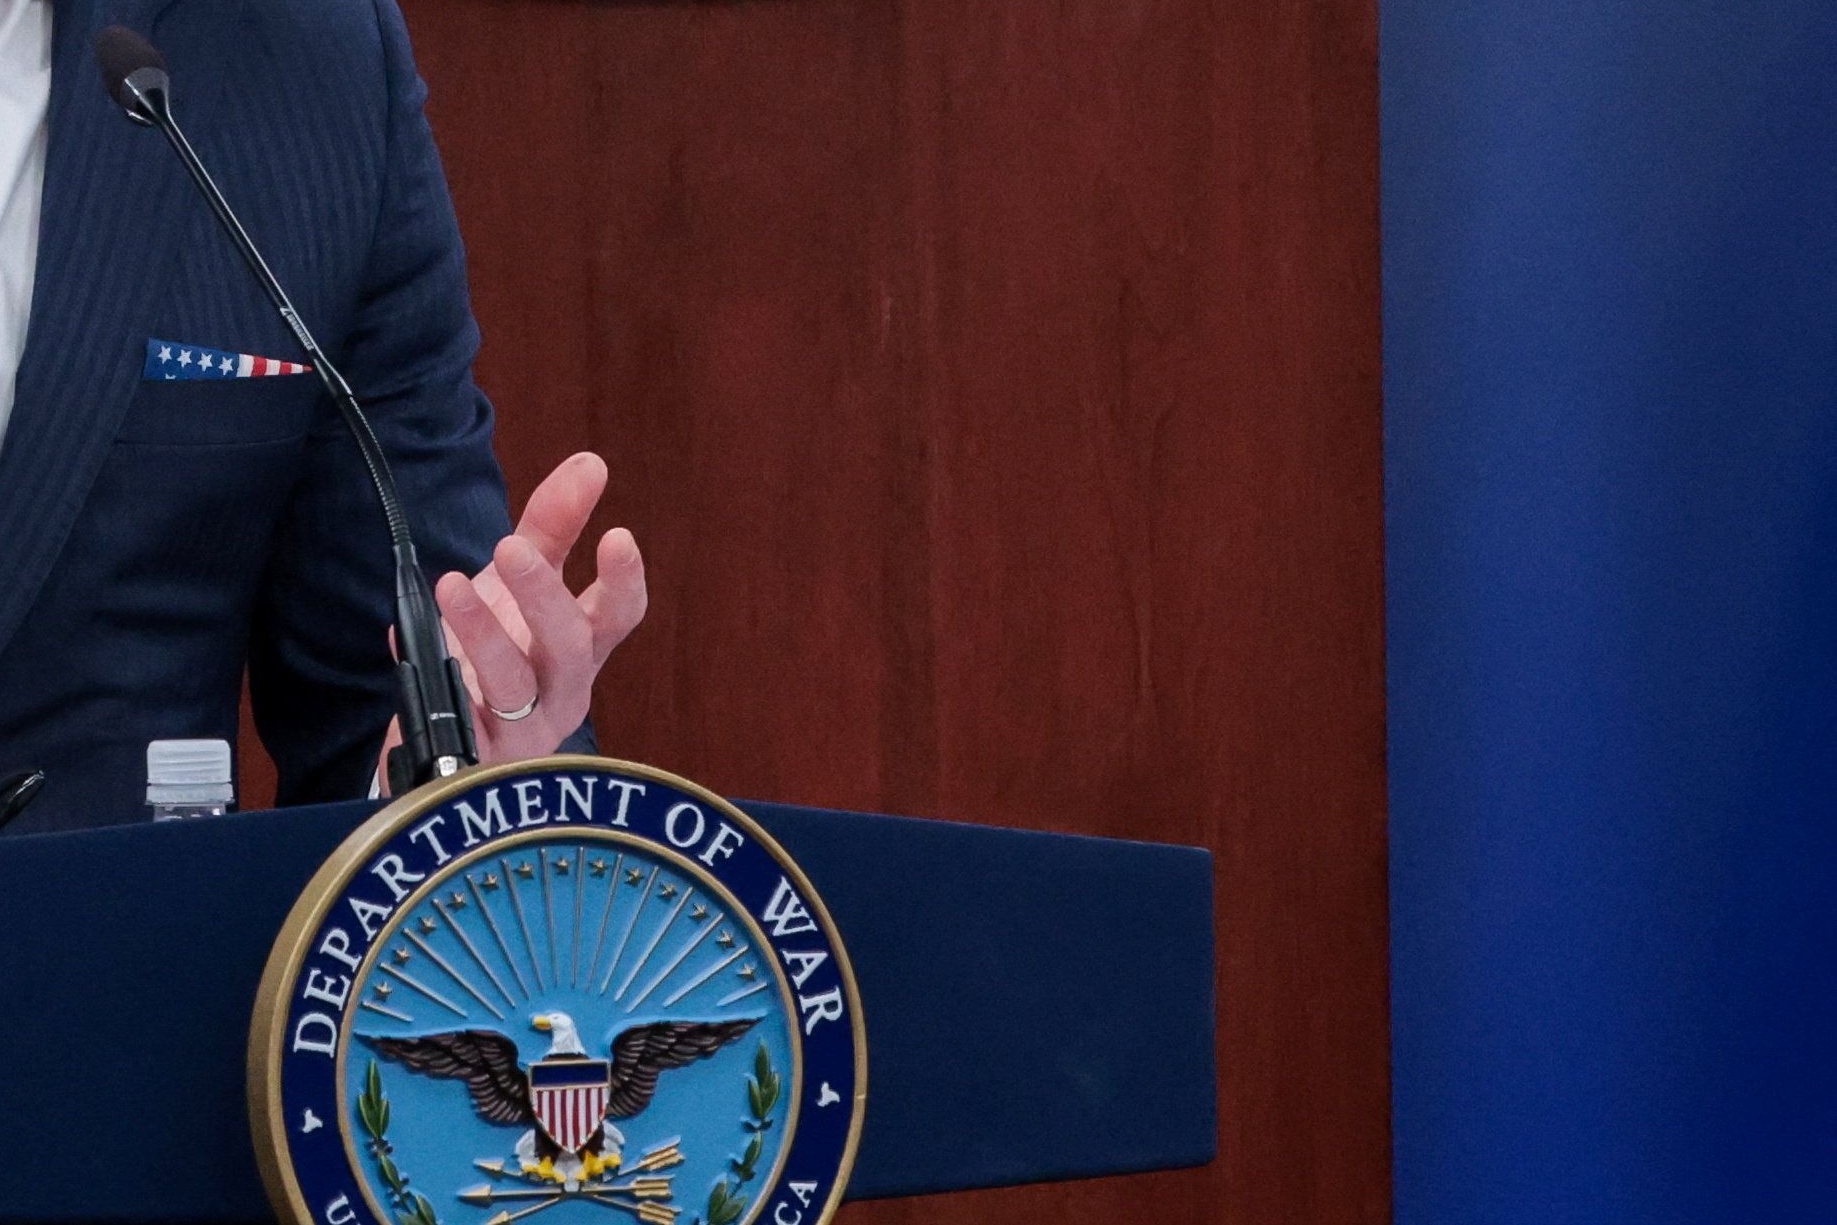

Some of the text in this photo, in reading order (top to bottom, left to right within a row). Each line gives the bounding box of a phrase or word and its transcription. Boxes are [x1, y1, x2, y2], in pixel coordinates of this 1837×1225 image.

[292, 776, 845, 1059] DEPARTMENT OF WAR
